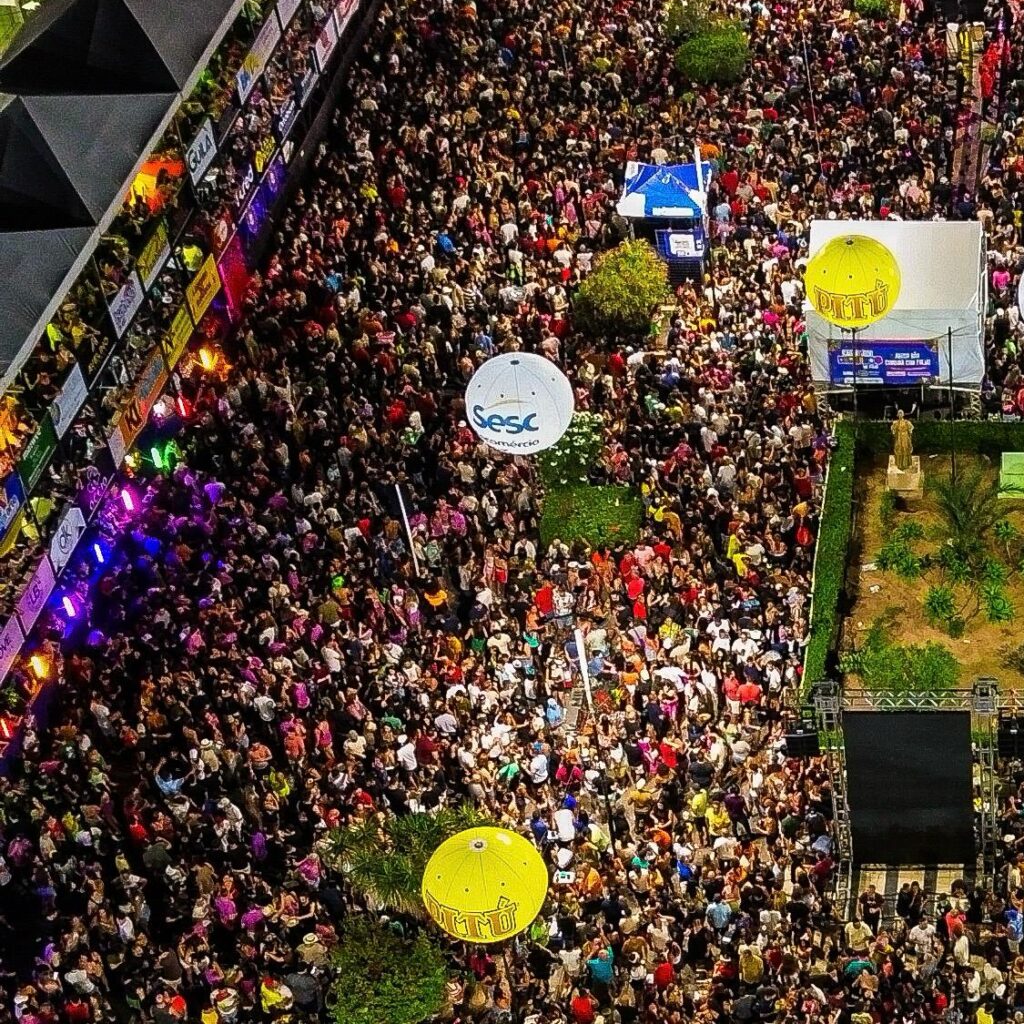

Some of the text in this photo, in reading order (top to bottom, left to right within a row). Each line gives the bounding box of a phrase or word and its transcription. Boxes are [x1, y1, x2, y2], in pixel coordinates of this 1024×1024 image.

[813, 278, 889, 321] PITÚ
[472, 403, 540, 435] Sesc
[424, 888, 518, 939] PITÚ
